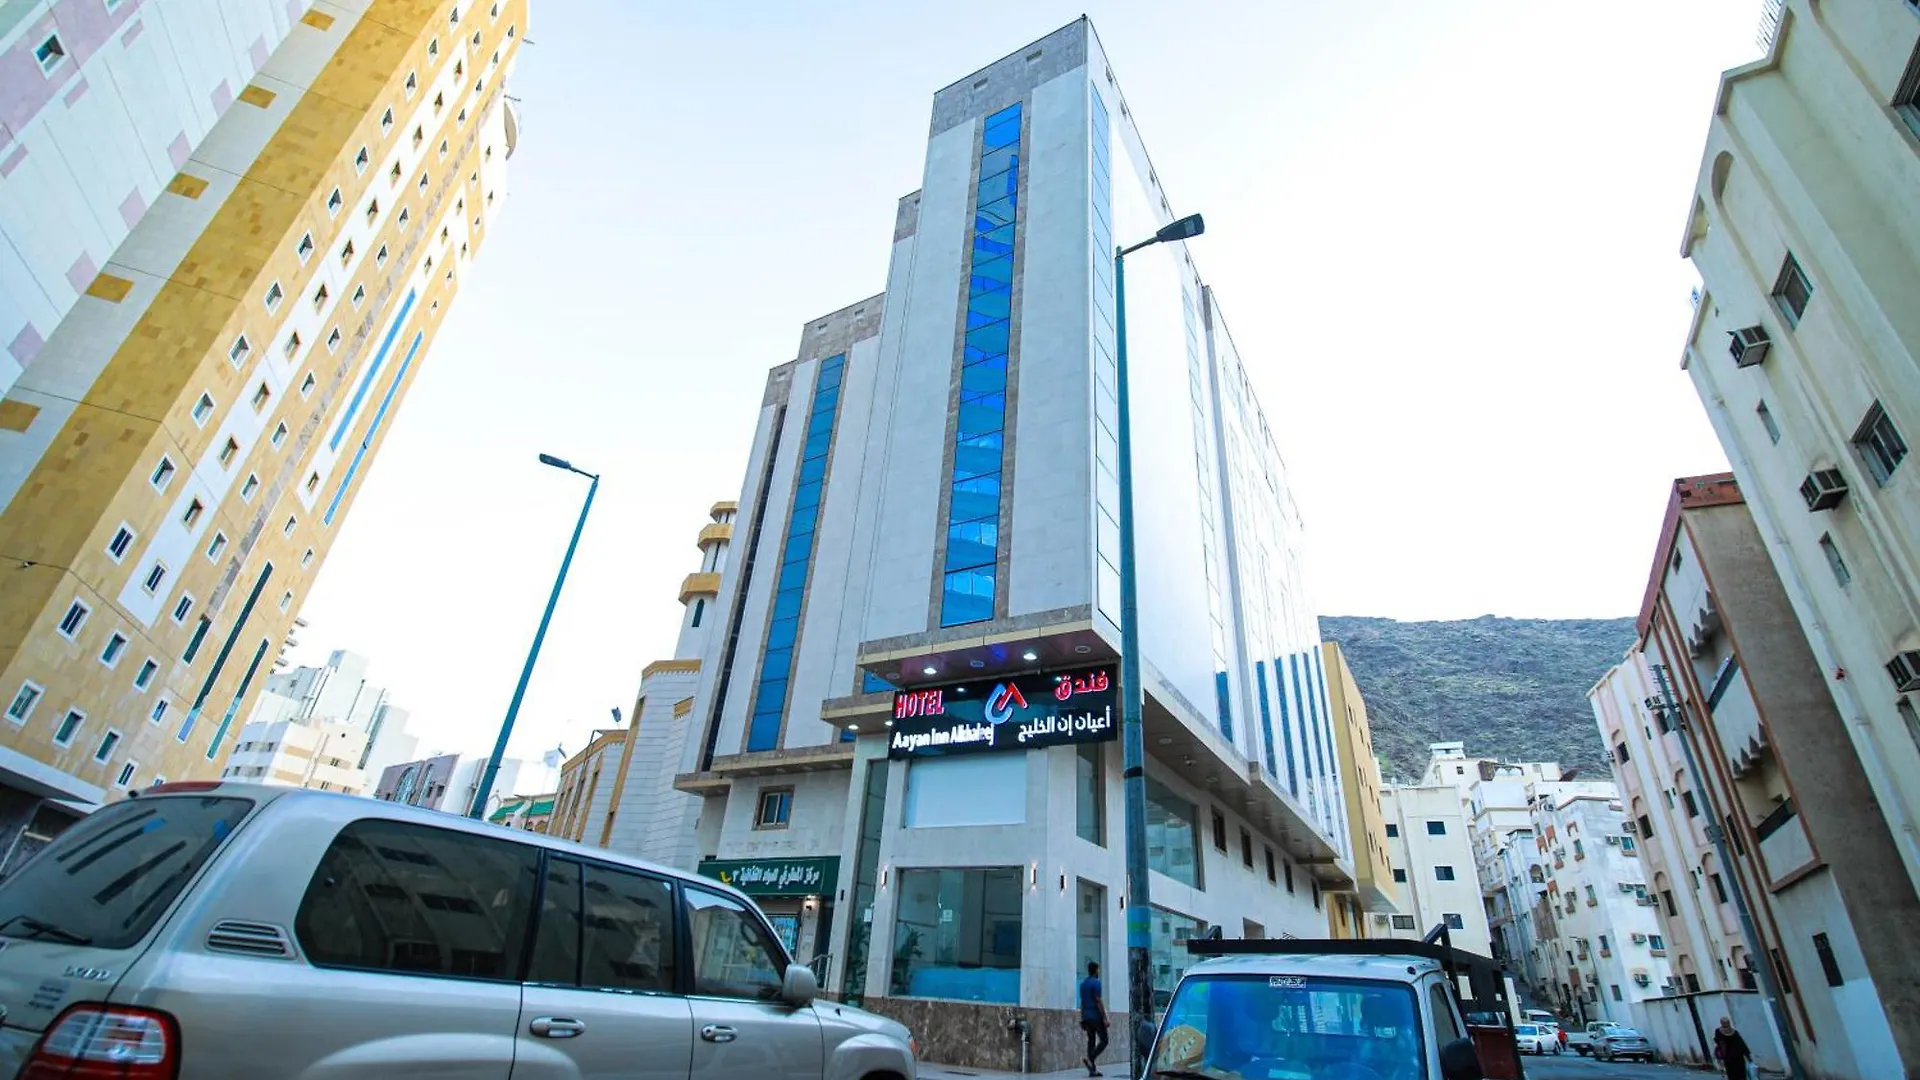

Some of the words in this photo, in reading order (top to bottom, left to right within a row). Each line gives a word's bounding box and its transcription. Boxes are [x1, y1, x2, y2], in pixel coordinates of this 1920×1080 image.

[1053, 669, 1109, 701] فندق
[895, 689, 944, 719] HOTEL
[1018, 716, 1056, 743] الخليج
[1057, 714, 1073, 737] إن
[1075, 705, 1111, 733] أعيان
[892, 732, 930, 752] Aayan
[931, 728, 950, 745] Inn
